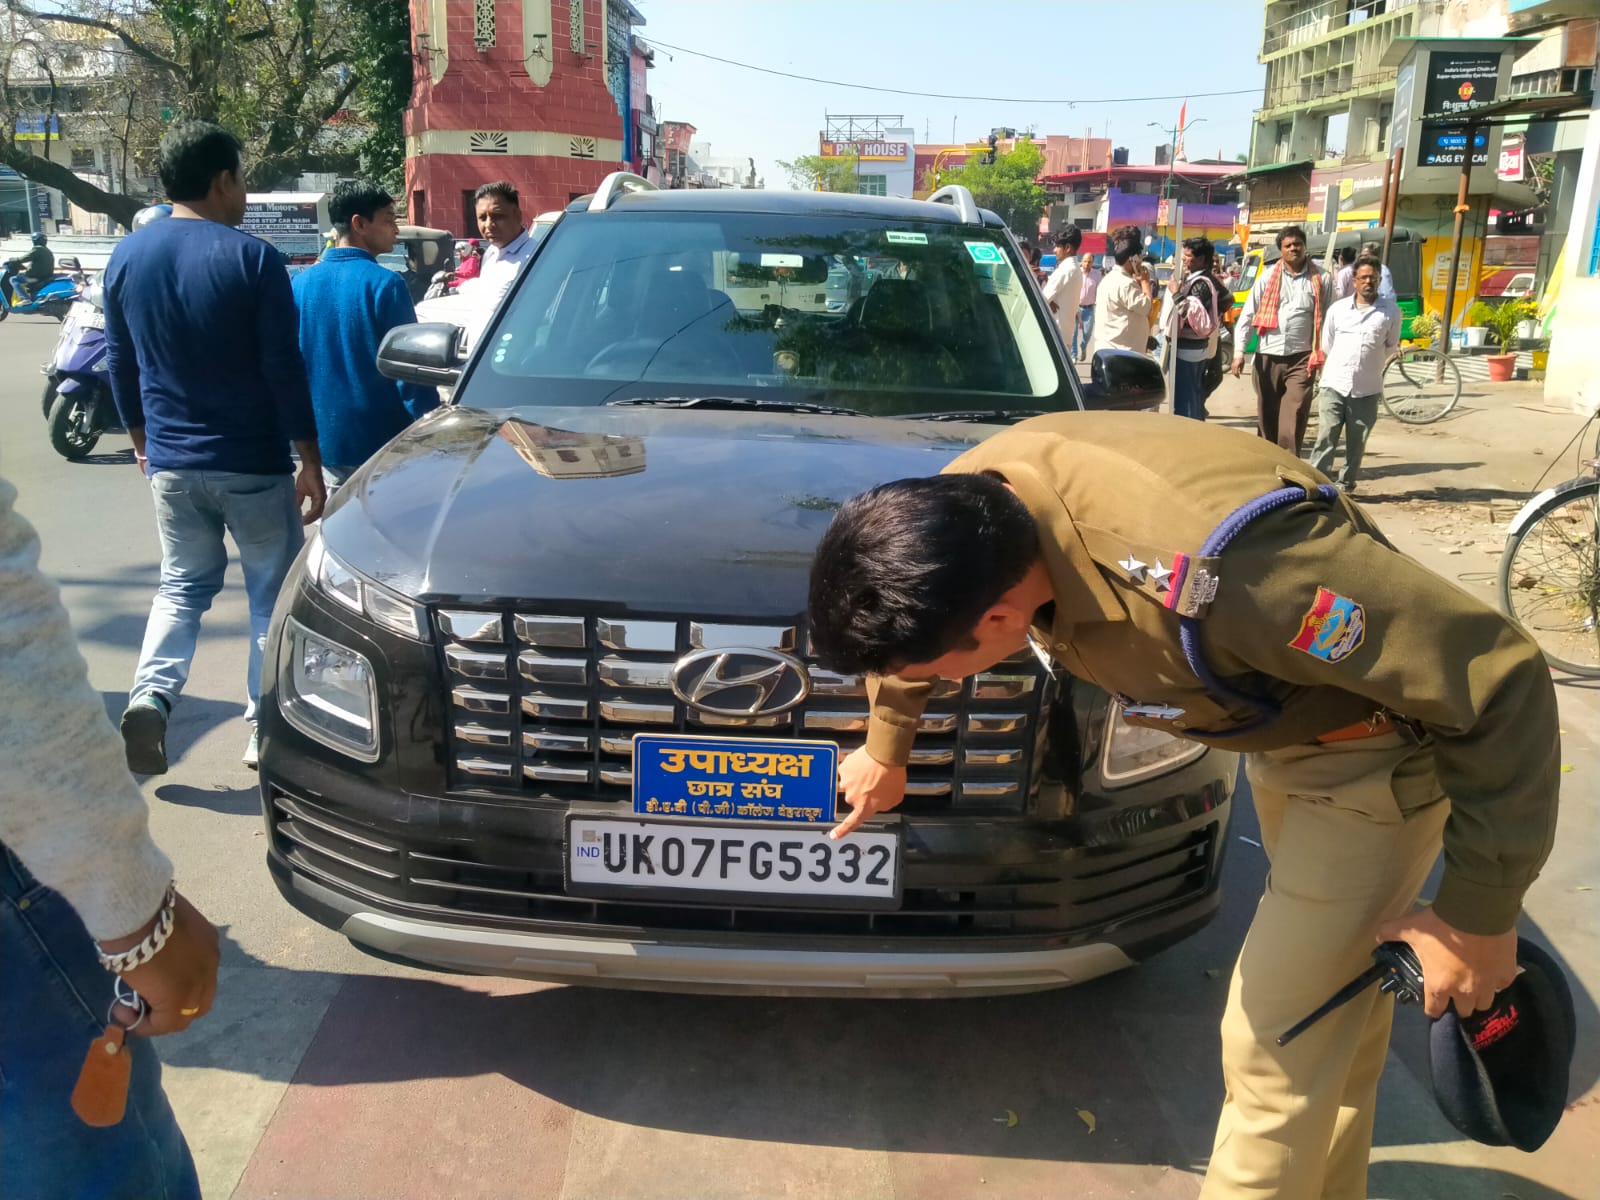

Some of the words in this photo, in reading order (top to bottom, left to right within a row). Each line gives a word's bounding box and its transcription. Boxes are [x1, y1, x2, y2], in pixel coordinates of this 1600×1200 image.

[865, 143, 904, 155] HOUSE
[1435, 154, 1452, 162] ASG
[1454, 154, 1465, 163] EY
[267, 202, 298, 211] Motors
[658, 748, 815, 777] उपाध्यक्ष
[686, 780, 735, 797] छात्र
[740, 778, 784, 799] संघ
[737, 802, 775, 817] कॉलेज
[576, 846, 600, 859] IND
[603, 832, 891, 886] UK07FG5332
